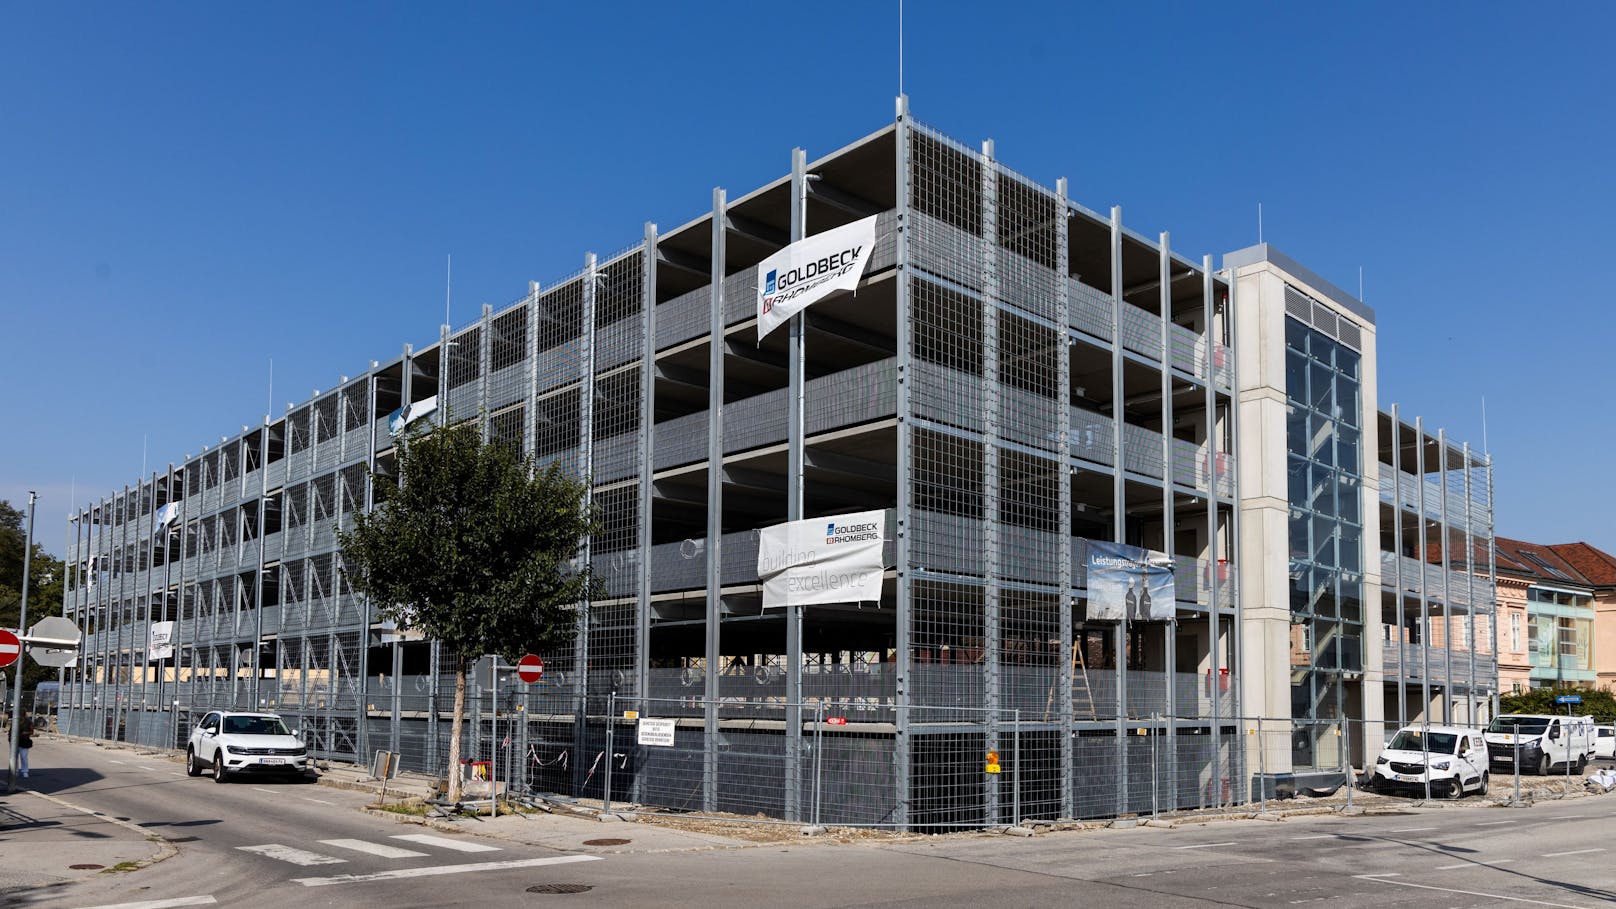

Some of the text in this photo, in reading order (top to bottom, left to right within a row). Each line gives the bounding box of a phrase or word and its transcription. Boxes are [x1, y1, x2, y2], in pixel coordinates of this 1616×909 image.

[777, 246, 862, 290] GOLDBECK
[834, 522, 878, 535] GOLDBECK
[834, 532, 878, 544] RHOMBERG
[763, 548, 816, 572] building
[789, 570, 868, 592] excellence
